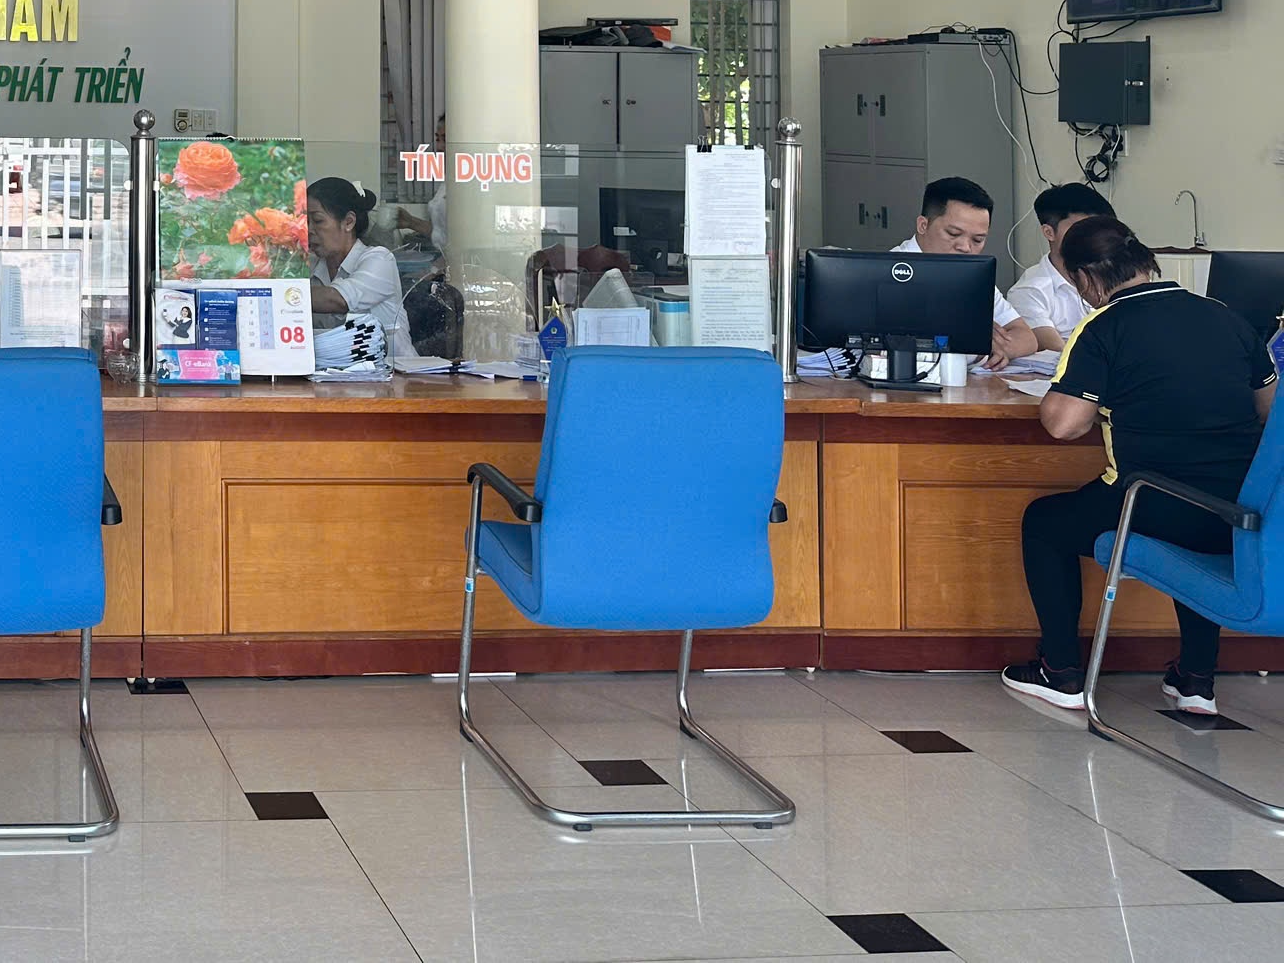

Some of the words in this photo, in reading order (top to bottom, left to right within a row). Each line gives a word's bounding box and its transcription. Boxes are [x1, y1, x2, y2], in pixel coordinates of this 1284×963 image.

[74, 47, 145, 103] TRIỂN
[400, 144, 445, 181] TÍN
[455, 153, 532, 191] DỤNG
[280, 326, 305, 343] 08
